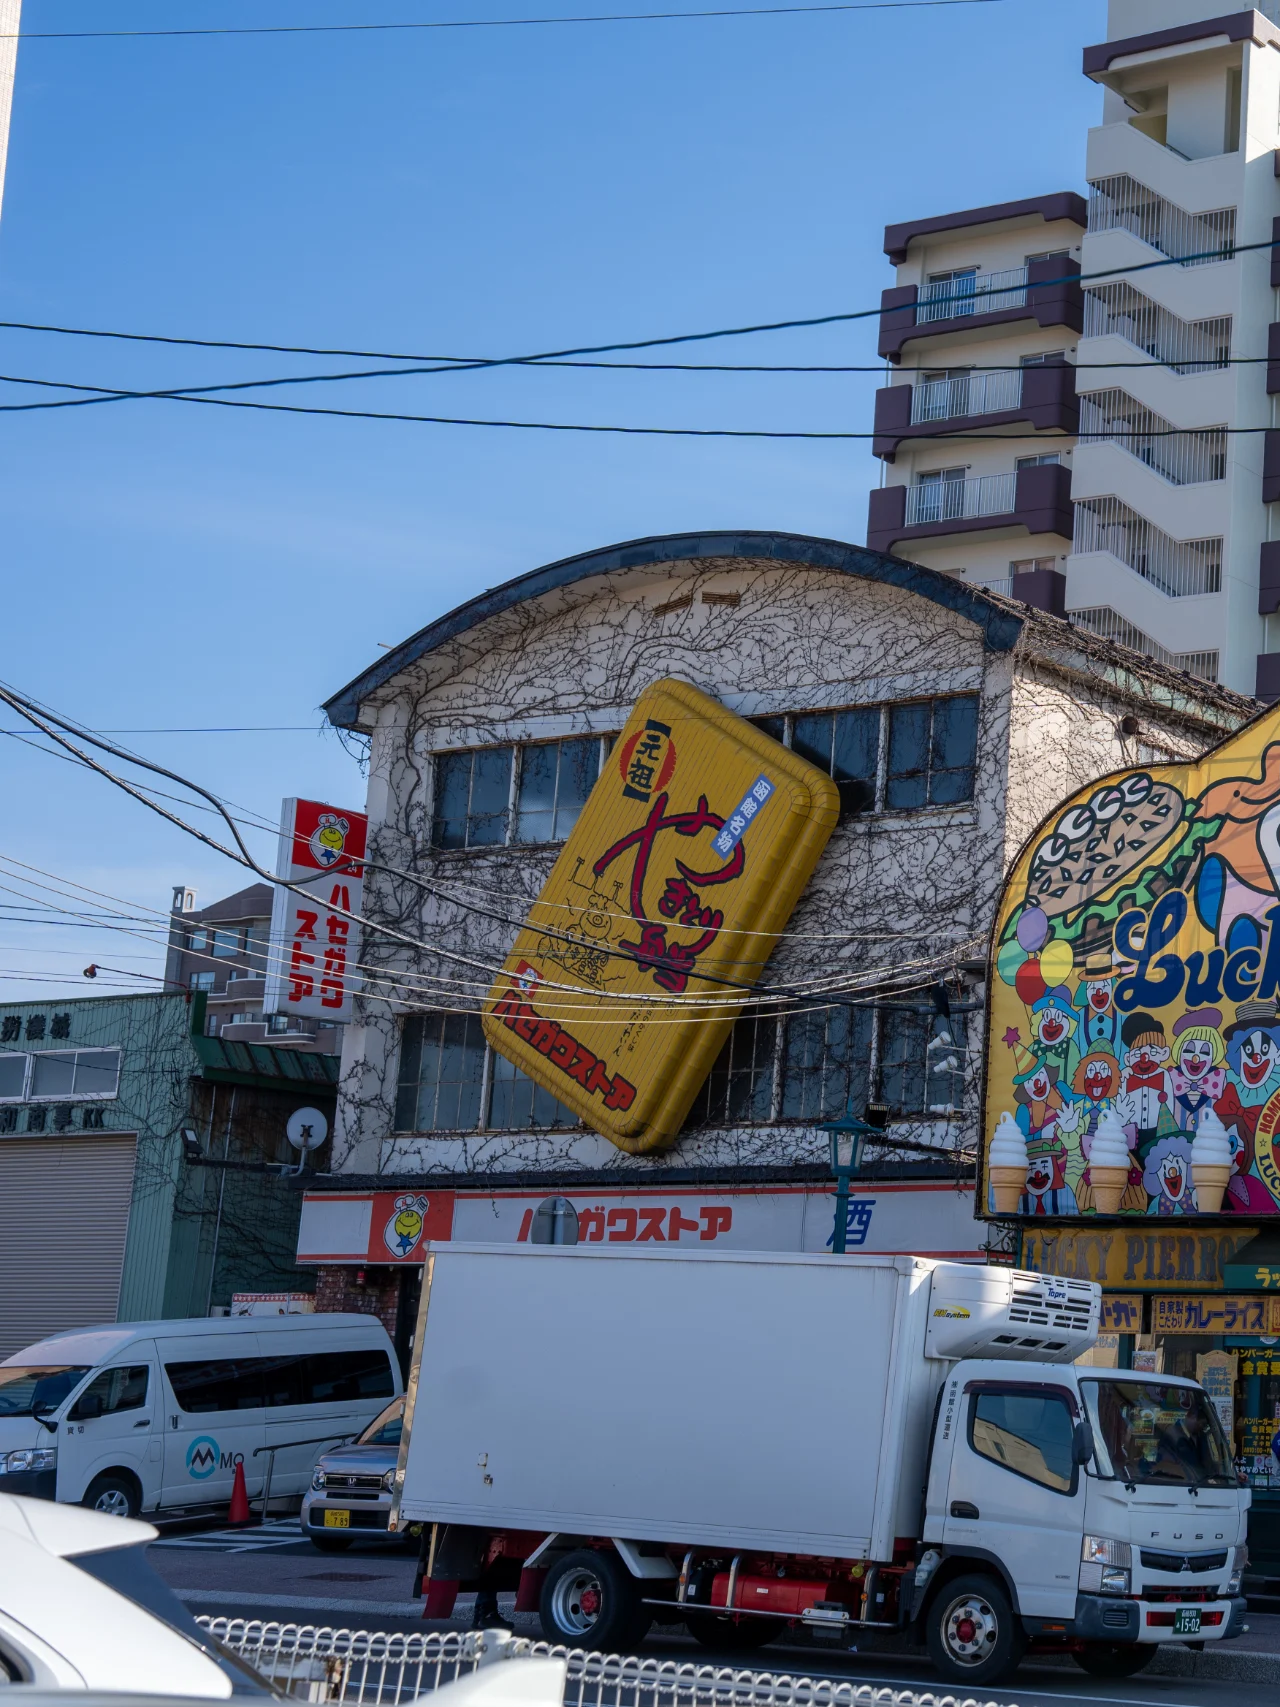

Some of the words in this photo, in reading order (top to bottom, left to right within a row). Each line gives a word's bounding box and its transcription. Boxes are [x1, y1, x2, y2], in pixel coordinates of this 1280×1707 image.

[716, 778, 772, 853] 函館名物
[288, 908, 319, 1003] ストア
[320, 883, 351, 1010] ハセガワ
[490, 989, 637, 1111] ハセガワストア
[516, 1205, 733, 1242] ガワストア
[1023, 1235, 1114, 1281] LUCKY
[1124, 1235, 1254, 1282] PIERRO
[1047, 1287, 1067, 1299] Topre
[1159, 1302, 1184, 1314] 自家製
[1159, 1316, 1183, 1329] こだわり
[1184, 1301, 1266, 1330] カレーライス
[66, 1426, 86, 1435] 貸切
[1150, 1531, 1224, 1540] FUSO
[1180, 1618, 1200, 1632] 15-02
